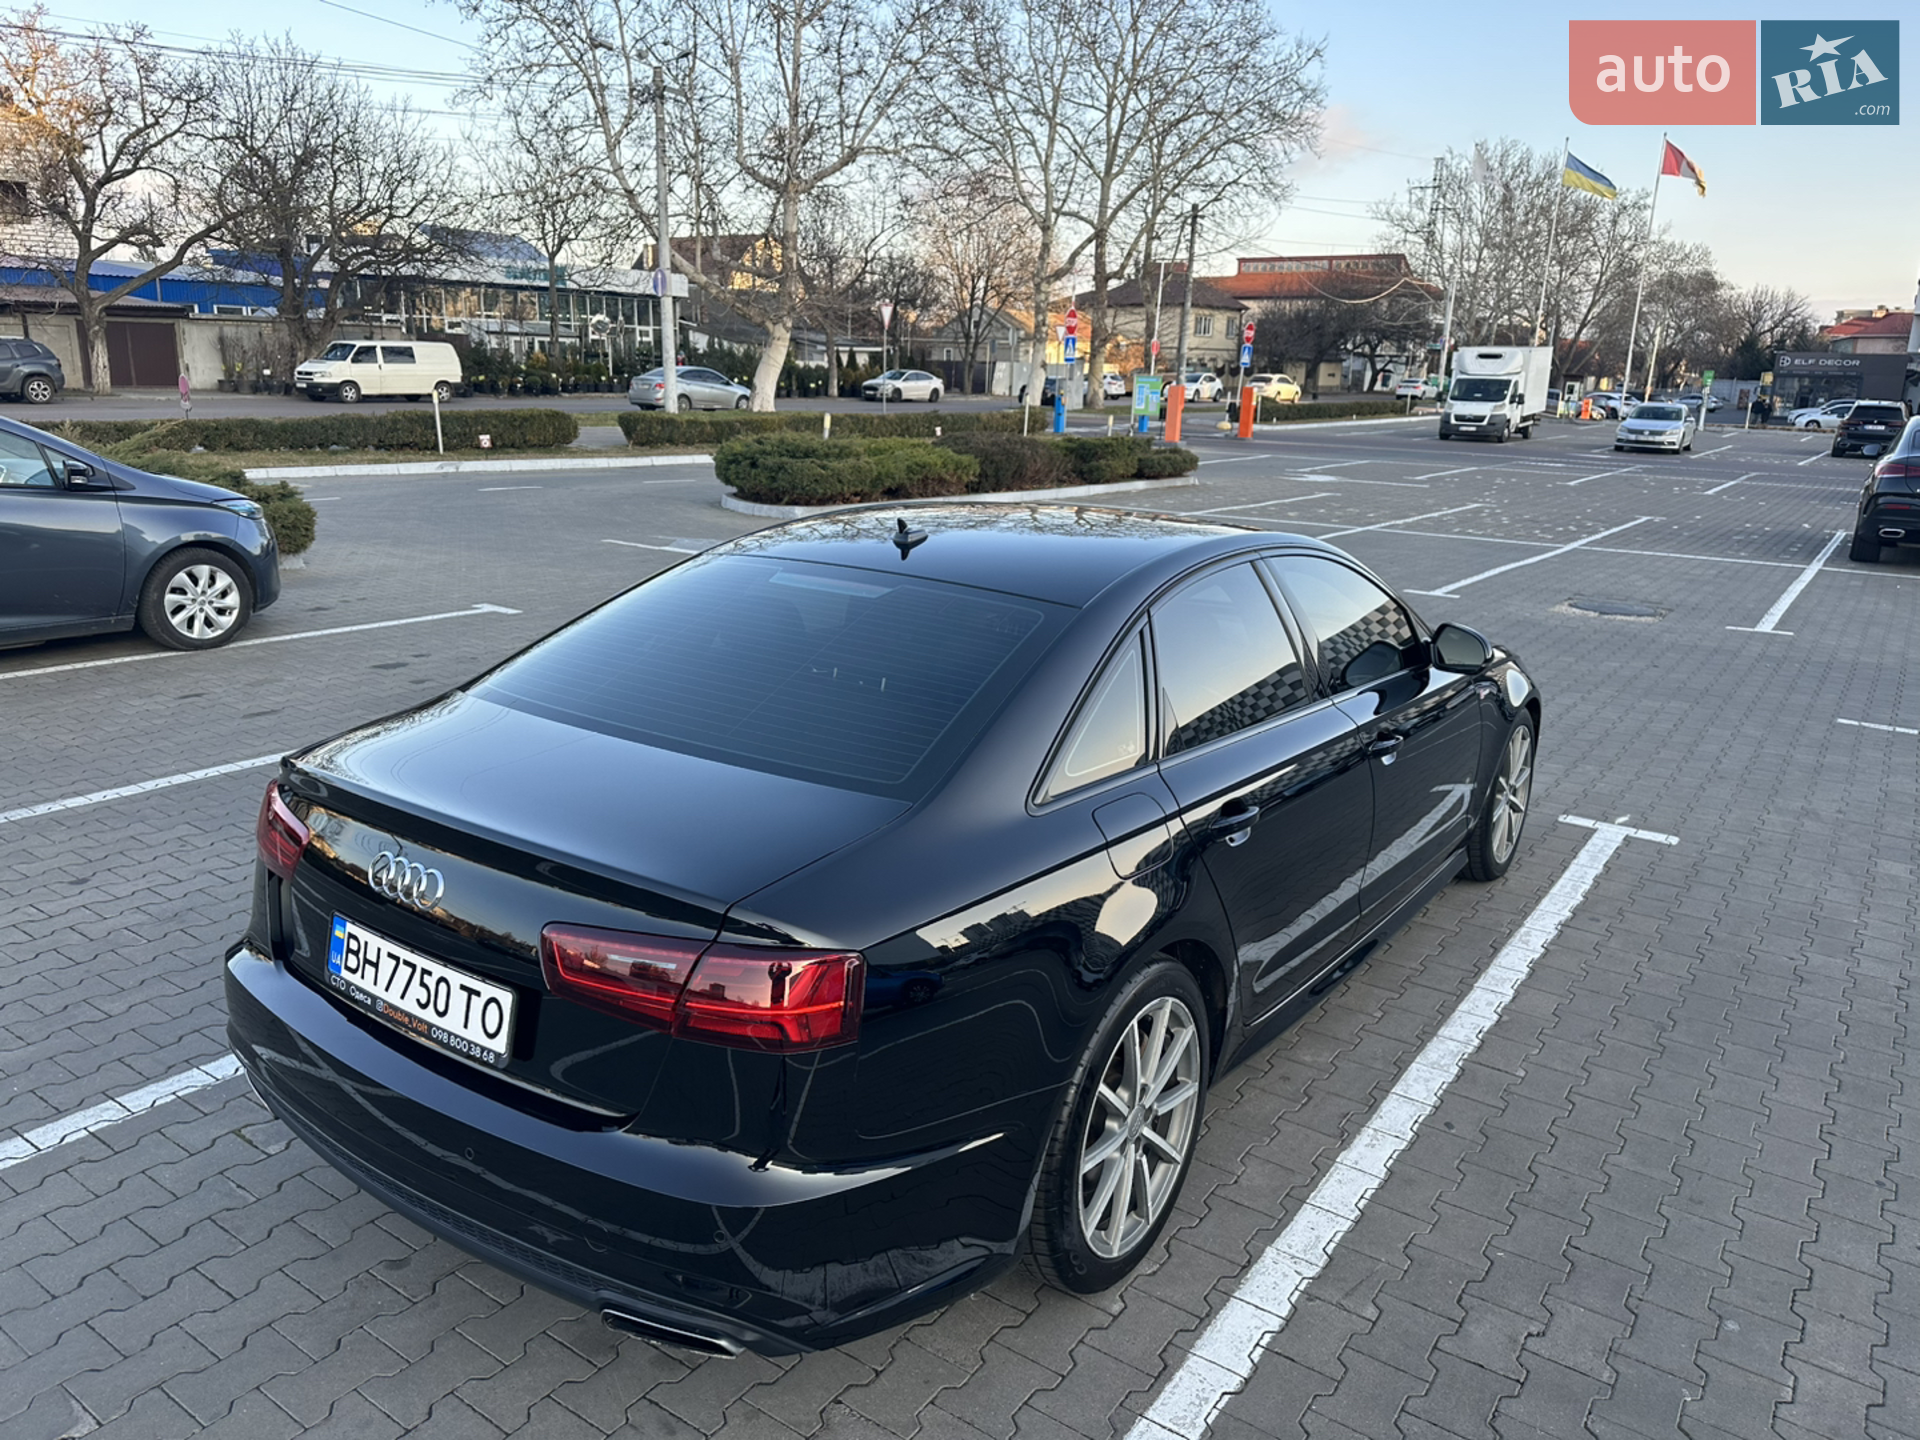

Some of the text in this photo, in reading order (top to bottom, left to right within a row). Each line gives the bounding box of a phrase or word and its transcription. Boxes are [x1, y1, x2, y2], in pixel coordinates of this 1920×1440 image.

[331, 951, 341, 966] UA
[431, 1027, 449, 1043] 098
[450, 1035, 468, 1052] 800
[469, 1043, 481, 1057] 38
[482, 1049, 495, 1063] 68
